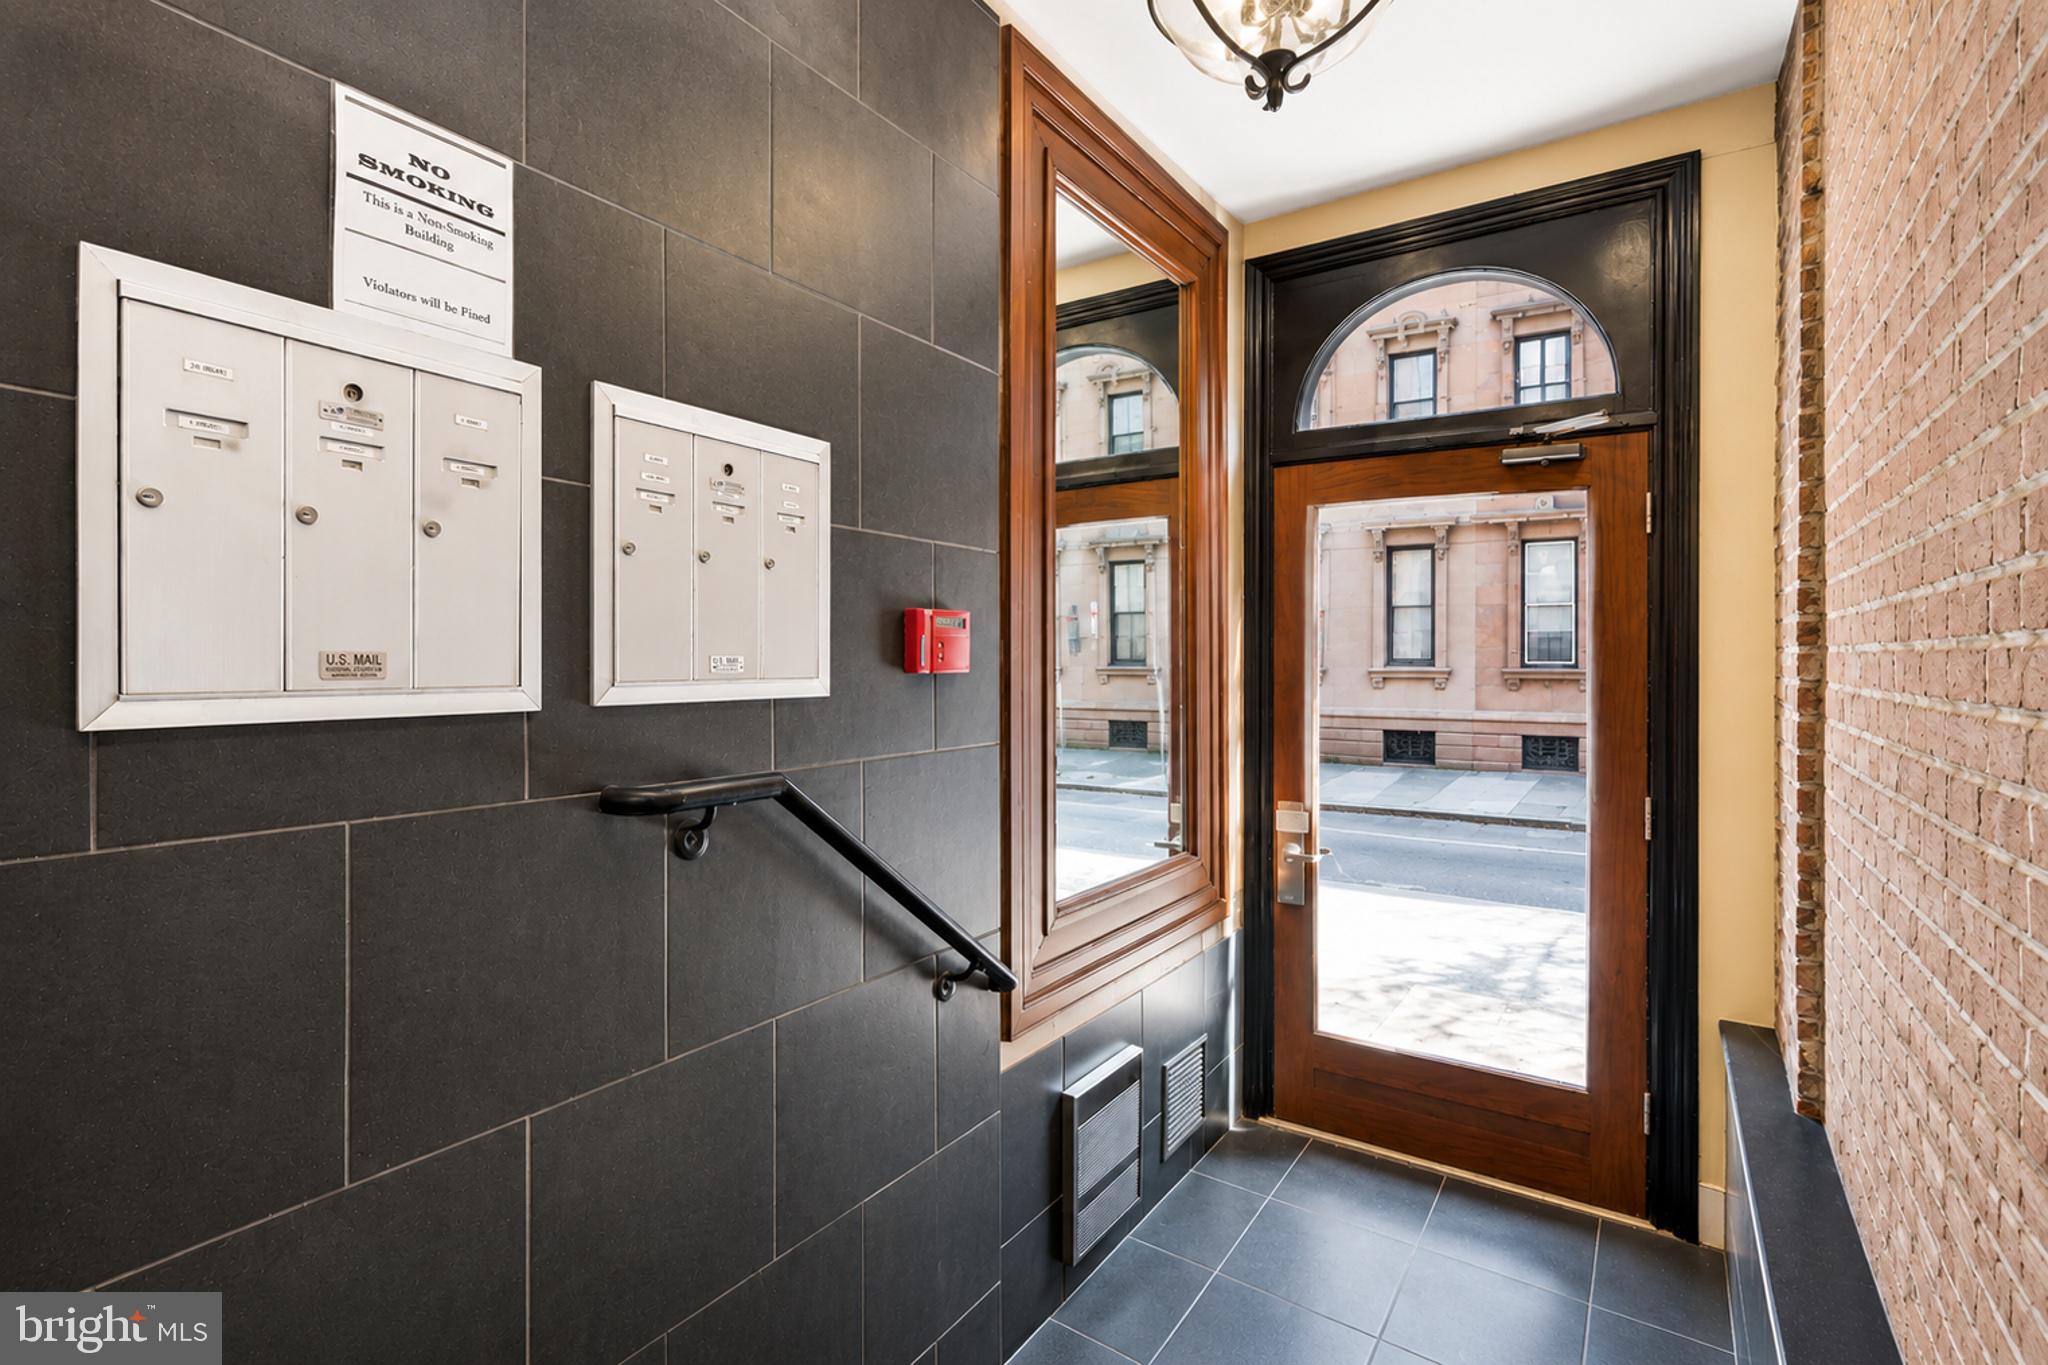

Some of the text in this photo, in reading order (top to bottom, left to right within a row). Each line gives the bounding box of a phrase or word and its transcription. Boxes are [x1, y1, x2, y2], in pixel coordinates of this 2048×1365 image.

[408, 152, 450, 181] NO
[357, 152, 495, 219] SMOKING
[362, 190, 494, 251] This is a Non-Smoking
[404, 223, 455, 252] Building
[362, 276, 417, 304] Violators
[420, 294, 441, 310] will
[444, 300, 458, 315] be
[326, 653, 382, 666] U.S. MAIL
